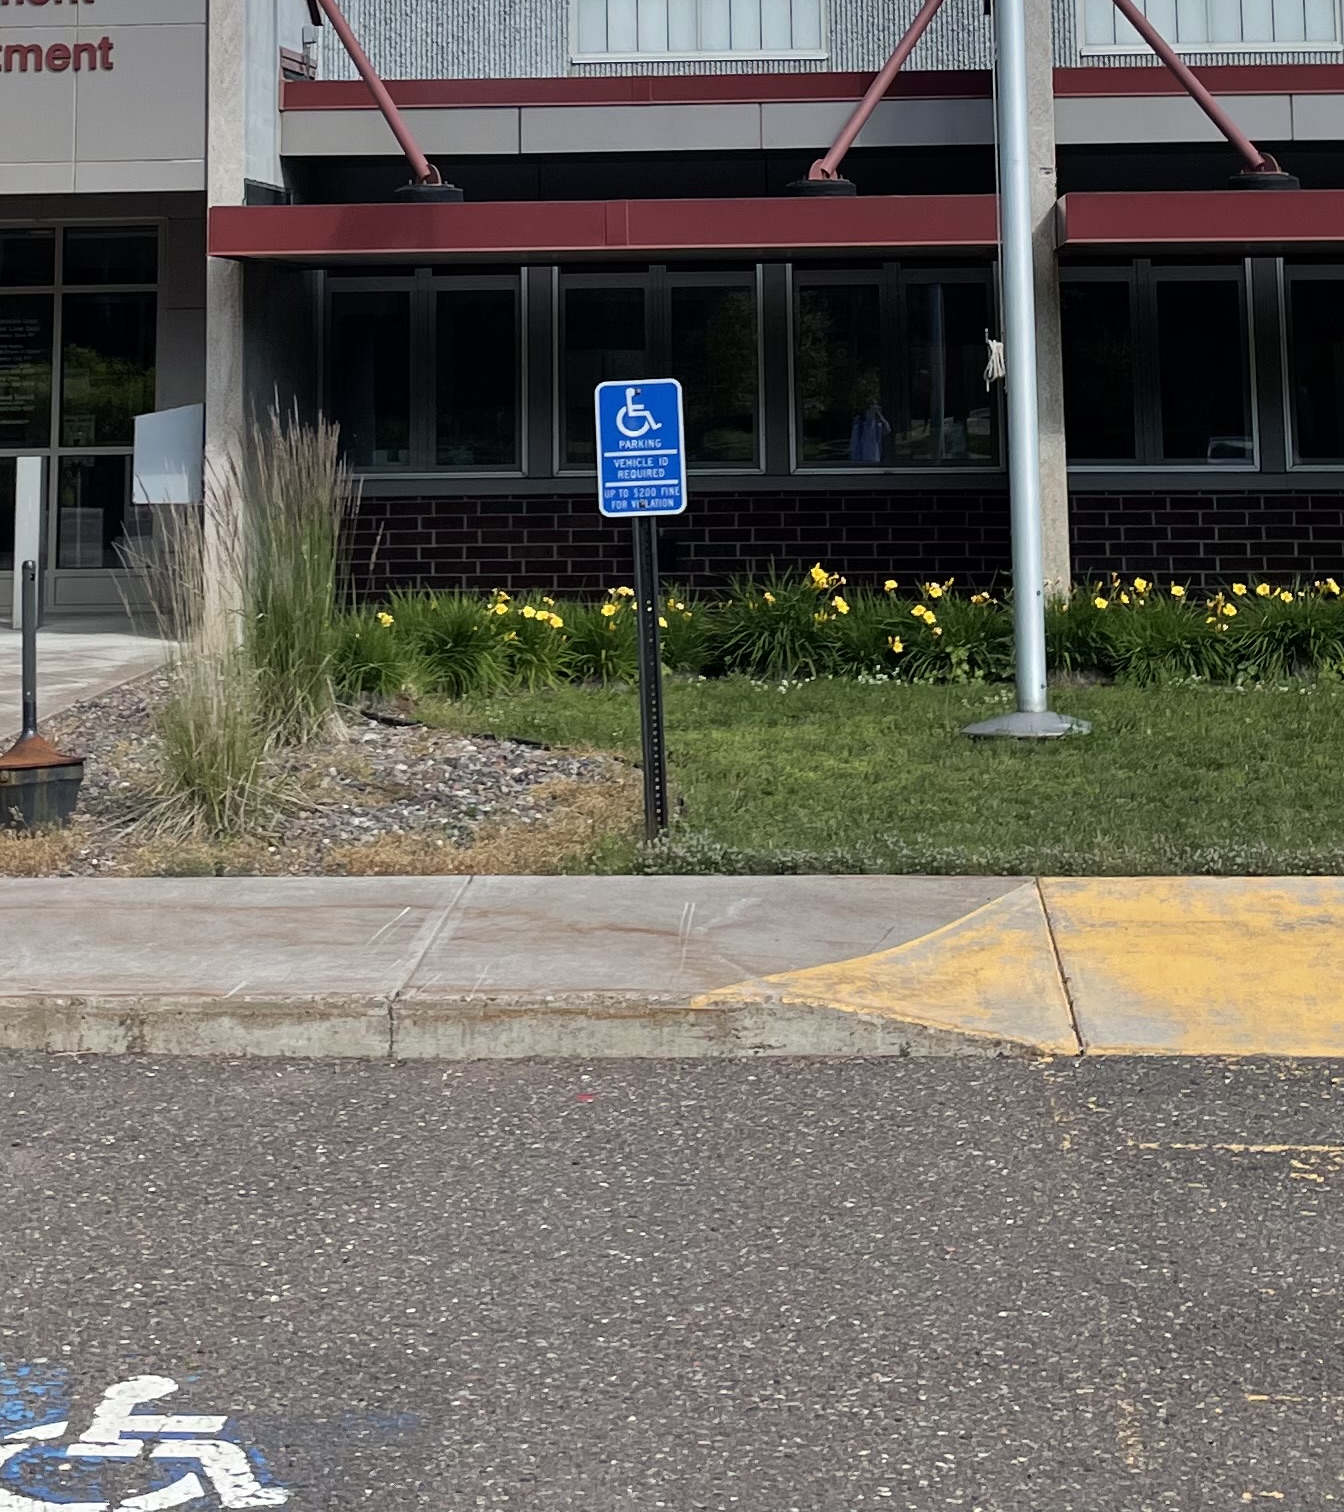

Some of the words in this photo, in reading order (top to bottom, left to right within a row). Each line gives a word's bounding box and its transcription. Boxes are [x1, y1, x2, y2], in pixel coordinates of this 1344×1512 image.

[619, 439, 662, 449] PARKING
[613, 458, 653, 468] VEHICLE
[659, 457, 669, 467] ID
[618, 468, 665, 479] REQUIRED
[605, 489, 615, 498] UP
[618, 488, 629, 498] TO
[634, 487, 656, 497] $200
[611, 500, 627, 510] FOR
[631, 499, 674, 509] VILATION
